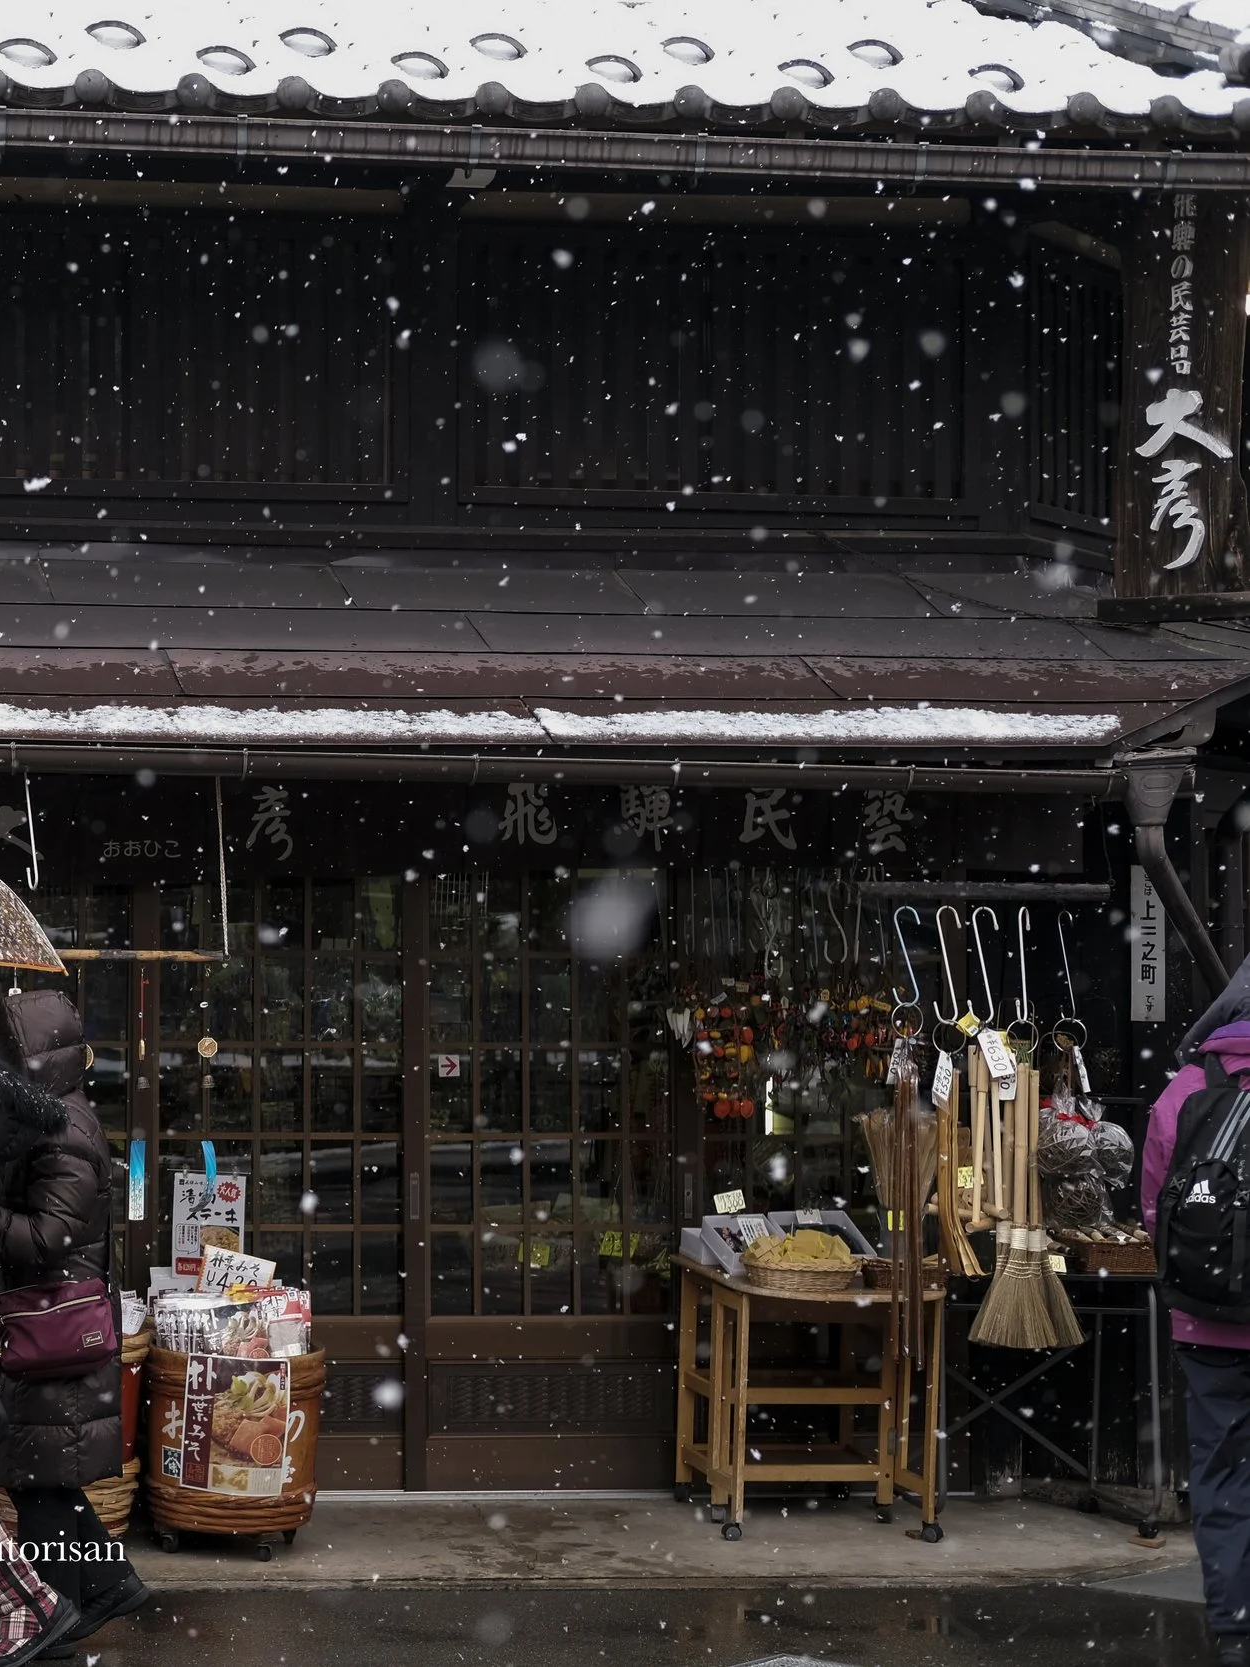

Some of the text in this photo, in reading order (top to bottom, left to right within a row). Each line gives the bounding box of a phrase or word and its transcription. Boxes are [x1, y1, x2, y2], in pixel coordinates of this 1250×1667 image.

[103, 839, 182, 859] おおひこ
[985, 1039, 1009, 1072] ¥630
[186, 1207, 238, 1224] ステーキ
[208, 1250, 261, 1278] 朴葉みそ
[184, 1357, 218, 1462] 朴葉みそ
